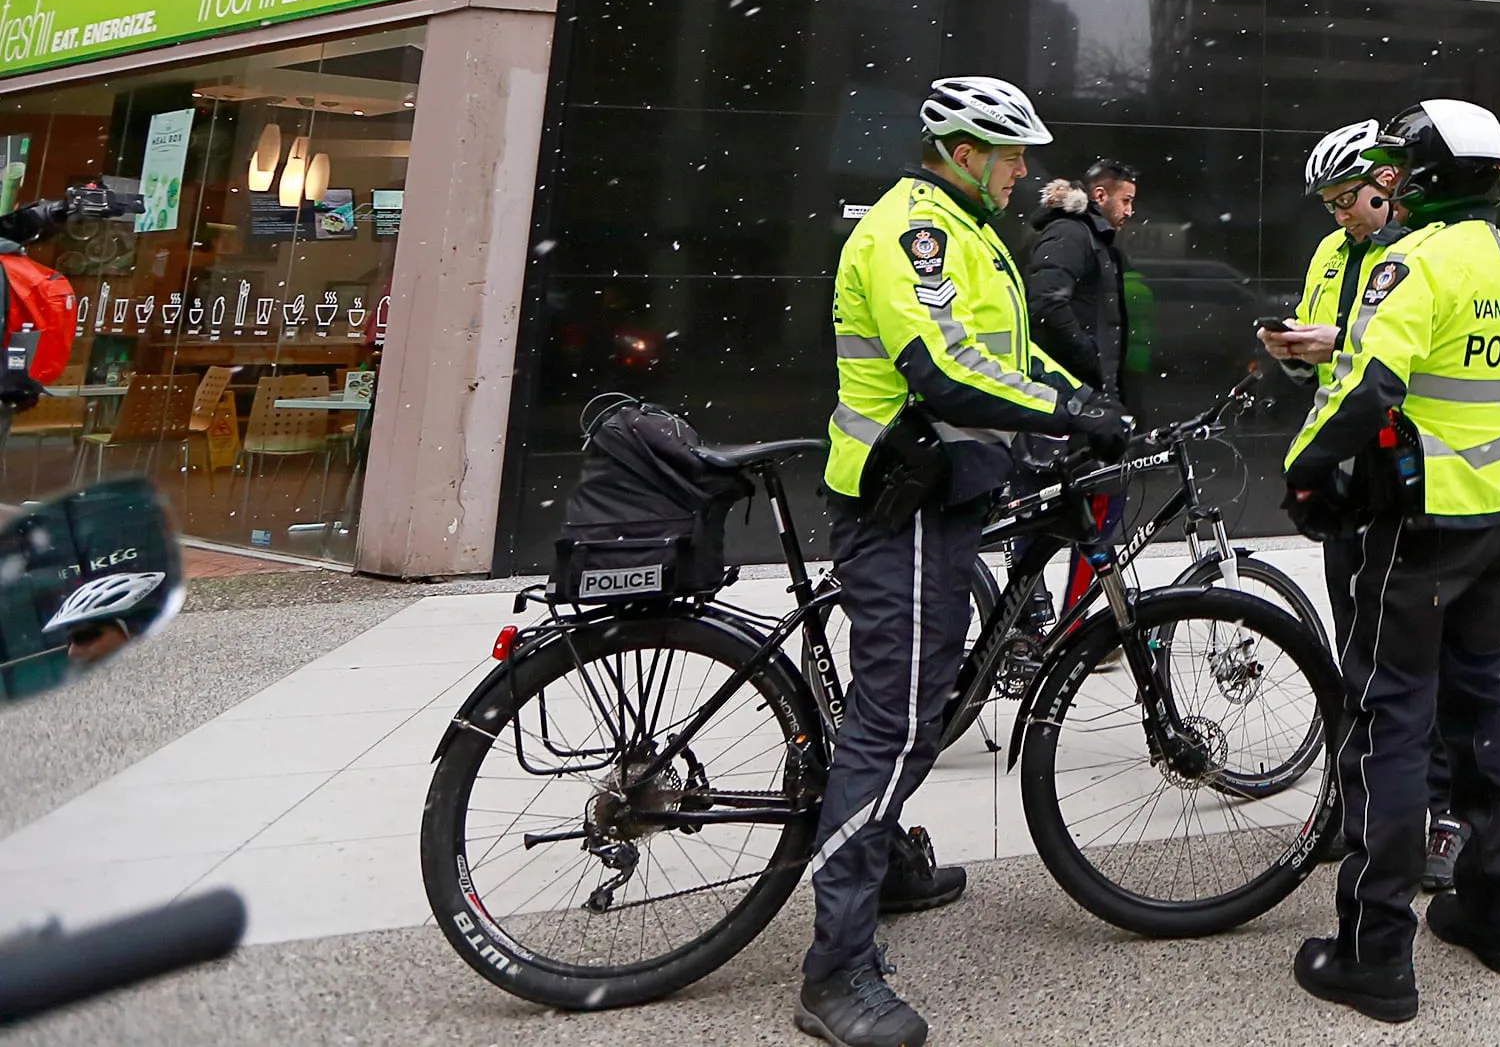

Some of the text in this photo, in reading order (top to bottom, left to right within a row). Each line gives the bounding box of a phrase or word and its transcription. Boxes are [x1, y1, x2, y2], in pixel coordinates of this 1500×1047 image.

[51, 27, 79, 53] EAT.
[81, 9, 158, 47] ENERGIZE.
[168, 134, 182, 143] BOX
[90, 548, 137, 571] KEG
[586, 571, 655, 591] POLICE
[813, 644, 844, 730] POLICE
[1047, 661, 1085, 723] WTB
[1291, 831, 1321, 869] SLICK
[453, 911, 510, 971] WTB
